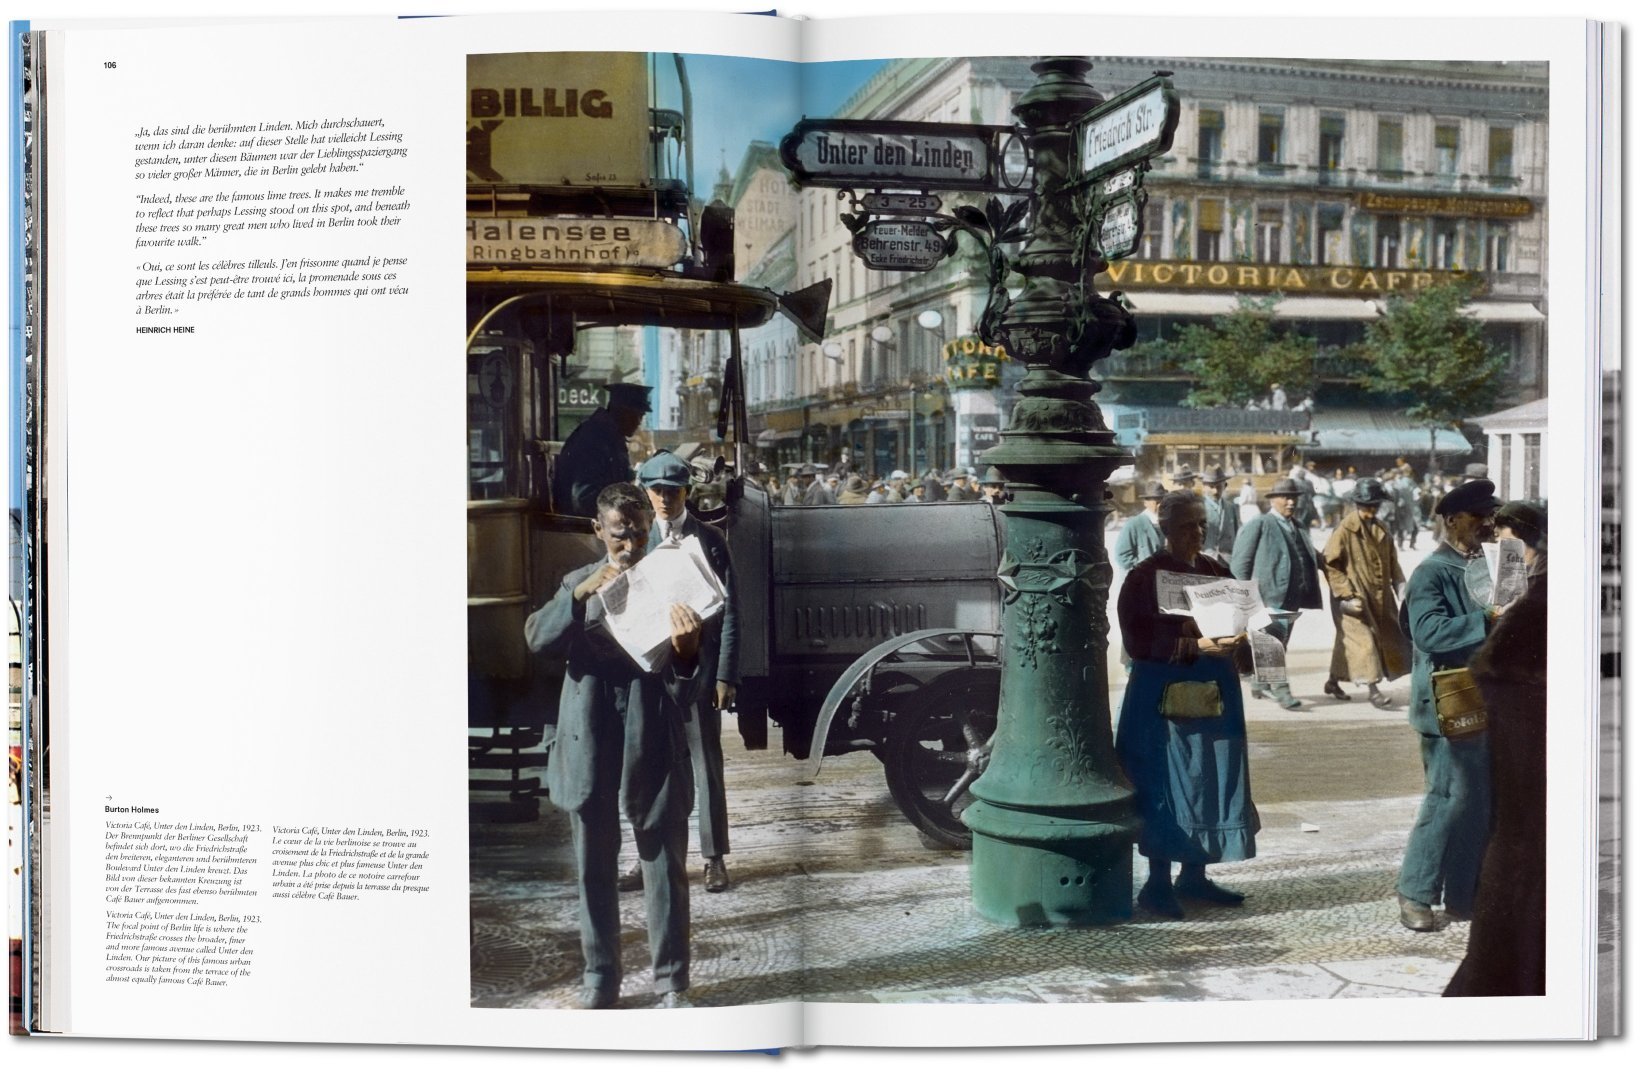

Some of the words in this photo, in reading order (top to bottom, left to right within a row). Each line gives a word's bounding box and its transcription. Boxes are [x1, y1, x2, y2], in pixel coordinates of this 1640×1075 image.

[471, 88, 613, 119] BILLIG
[135, 127, 151, 138] „Ja,
[153, 126, 169, 136] das
[170, 124, 190, 136] sind
[191, 124, 206, 135] die
[208, 123, 256, 134] berühmten
[258, 121, 293, 132] Linden.
[295, 119, 319, 130] Mich
[320, 117, 385, 129] durchschauert,
[1088, 113, 1132, 158] Friedrich
[1135, 102, 1155, 135] Str.
[135, 143, 160, 151] wenn
[162, 140, 176, 150] ich
[178, 139, 205, 150] daran
[207, 138, 237, 149] denke:
[239, 136, 256, 149] auf
[256, 136, 283, 147] dieser
[284, 134, 309, 145] Stelle
[310, 134, 326, 144] hat
[328, 131, 367, 144] vielleicht
[369, 131, 403, 143] Lessing
[134, 154, 181, 167] gestanden,
[183, 155, 208, 164] unter
[209, 152, 237, 163] diesen
[240, 152, 277, 162] Bäumen
[279, 152, 299, 160] war
[299, 149, 315, 160] der
[317, 147, 408, 160] Lieblingsspaziergang
[817, 135, 867, 166] Unter
[873, 138, 907, 168] den
[911, 138, 974, 172] Linden
[135, 172, 146, 180] so
[148, 169, 172, 180] vieler
[173, 168, 203, 181] großer
[204, 168, 242, 178] Männer,
[243, 166, 259, 176] die
[260, 166, 270, 176] in
[272, 164, 299, 175] Berlin
[300, 163, 327, 177] gelebt
[329, 162, 364, 173] haben.“
[136, 193, 172, 204] “Indeed,
[175, 193, 198, 203] these
[199, 195, 214, 203] are
[215, 191, 230, 202] the
[231, 191, 265, 203] famous
[267, 190, 287, 200] lime
[288, 191, 312, 200] trees.
[314, 189, 321, 198] It
[323, 187, 352, 198] makes
[371, 185, 405, 197] tremble
[881, 196, 890, 207] 3
[148, 207, 174, 220] reflect
[176, 207, 194, 218] that
[196, 206, 232, 220] perhaps
[234, 206, 267, 218] Lessing
[269, 204, 295, 215] stood
[311, 203, 328, 213] this
[330, 203, 352, 215] spot,
[354, 201, 373, 212] and
[375, 200, 411, 211] beneath
[135, 222, 158, 233] these
[159, 224, 180, 232] trees
[195, 224, 221, 234] many
[222, 222, 245, 233] great
[247, 222, 268, 230] men
[269, 219, 290, 229] who
[292, 218, 315, 229] lived
[316, 219, 326, 228] in
[328, 216, 355, 228] Berlin
[357, 215, 378, 227] took
[380, 215, 402, 226] their
[466, 220, 631, 241] Halensee
[873, 225, 929, 237] Feuer-Melder
[135, 237, 175, 249] favourite
[177, 236, 207, 246] walk.”
[861, 237, 922, 252] Behrenstr.
[924, 240, 940, 252] 49
[473, 245, 631, 262] Ringbahnhof)
[135, 278, 153, 288] que
[154, 276, 188, 288] Lessing
[189, 275, 208, 285] s’est
[209, 274, 250, 287] peut-être
[251, 273, 281, 284] trouvé
[282, 273, 296, 284] ici,
[298, 272, 307, 282] la
[308, 270, 360, 285] promenade
[361, 273, 382, 281] sous
[1107, 260, 1306, 288] VICTORIA
[136, 326, 172, 334] HEINRICH
[173, 326, 195, 334] HEINE
[104, 805, 130, 813] Burton
[131, 805, 160, 814] Holmes
[106, 821, 133, 829] Victoria
[134, 822, 152, 831] Café,
[154, 822, 173, 830] Unter
[174, 822, 188, 830] den
[189, 823, 216, 832] Linden,
[217, 823, 240, 832] Berlin,
[243, 824, 262, 832] 1923.
[273, 826, 300, 834] Victoria
[301, 827, 320, 836] Café,
[321, 827, 341, 835] Unter
[342, 827, 356, 836] den
[357, 828, 384, 837] Linden,
[386, 829, 409, 838] Berlin,
[411, 829, 430, 838] 1923.
[105, 895, 122, 904] Café
[124, 895, 145, 903] Bauer
[146, 896, 199, 905] aufgenommen.
[106, 911, 133, 919] Victoria
[134, 911, 153, 921] Café,
[154, 912, 174, 920] Unter
[190, 913, 217, 922] Linden,
[218, 914, 241, 923] Berlin,
[243, 915, 262, 923] 1923.
